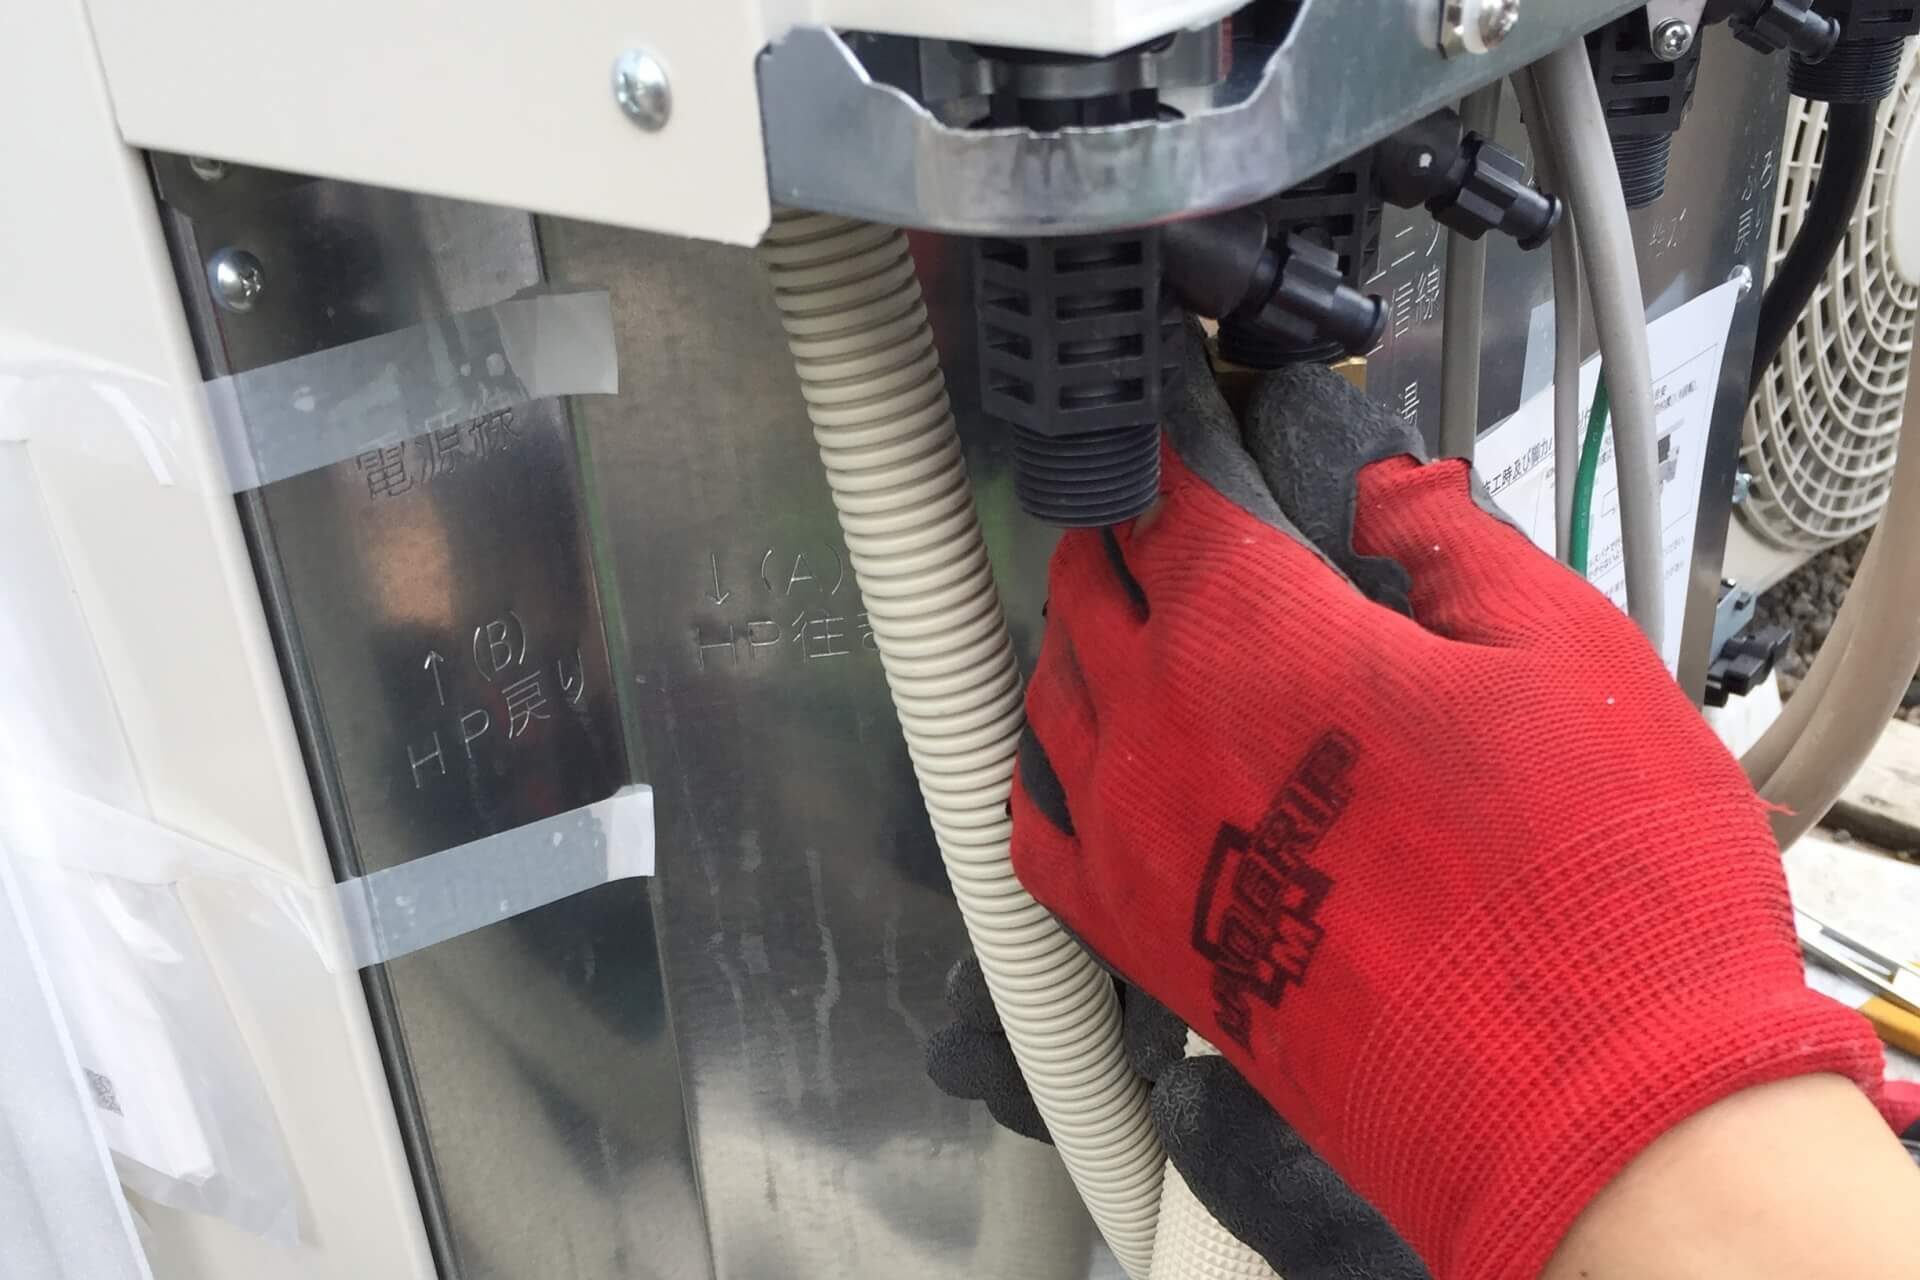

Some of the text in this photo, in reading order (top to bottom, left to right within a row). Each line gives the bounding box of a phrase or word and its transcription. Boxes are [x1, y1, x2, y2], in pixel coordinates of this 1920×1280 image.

[356, 386, 522, 499] 電源線
[760, 544, 845, 597] (A)
[472, 609, 528, 682] (B)
[695, 610, 880, 673] HP往
